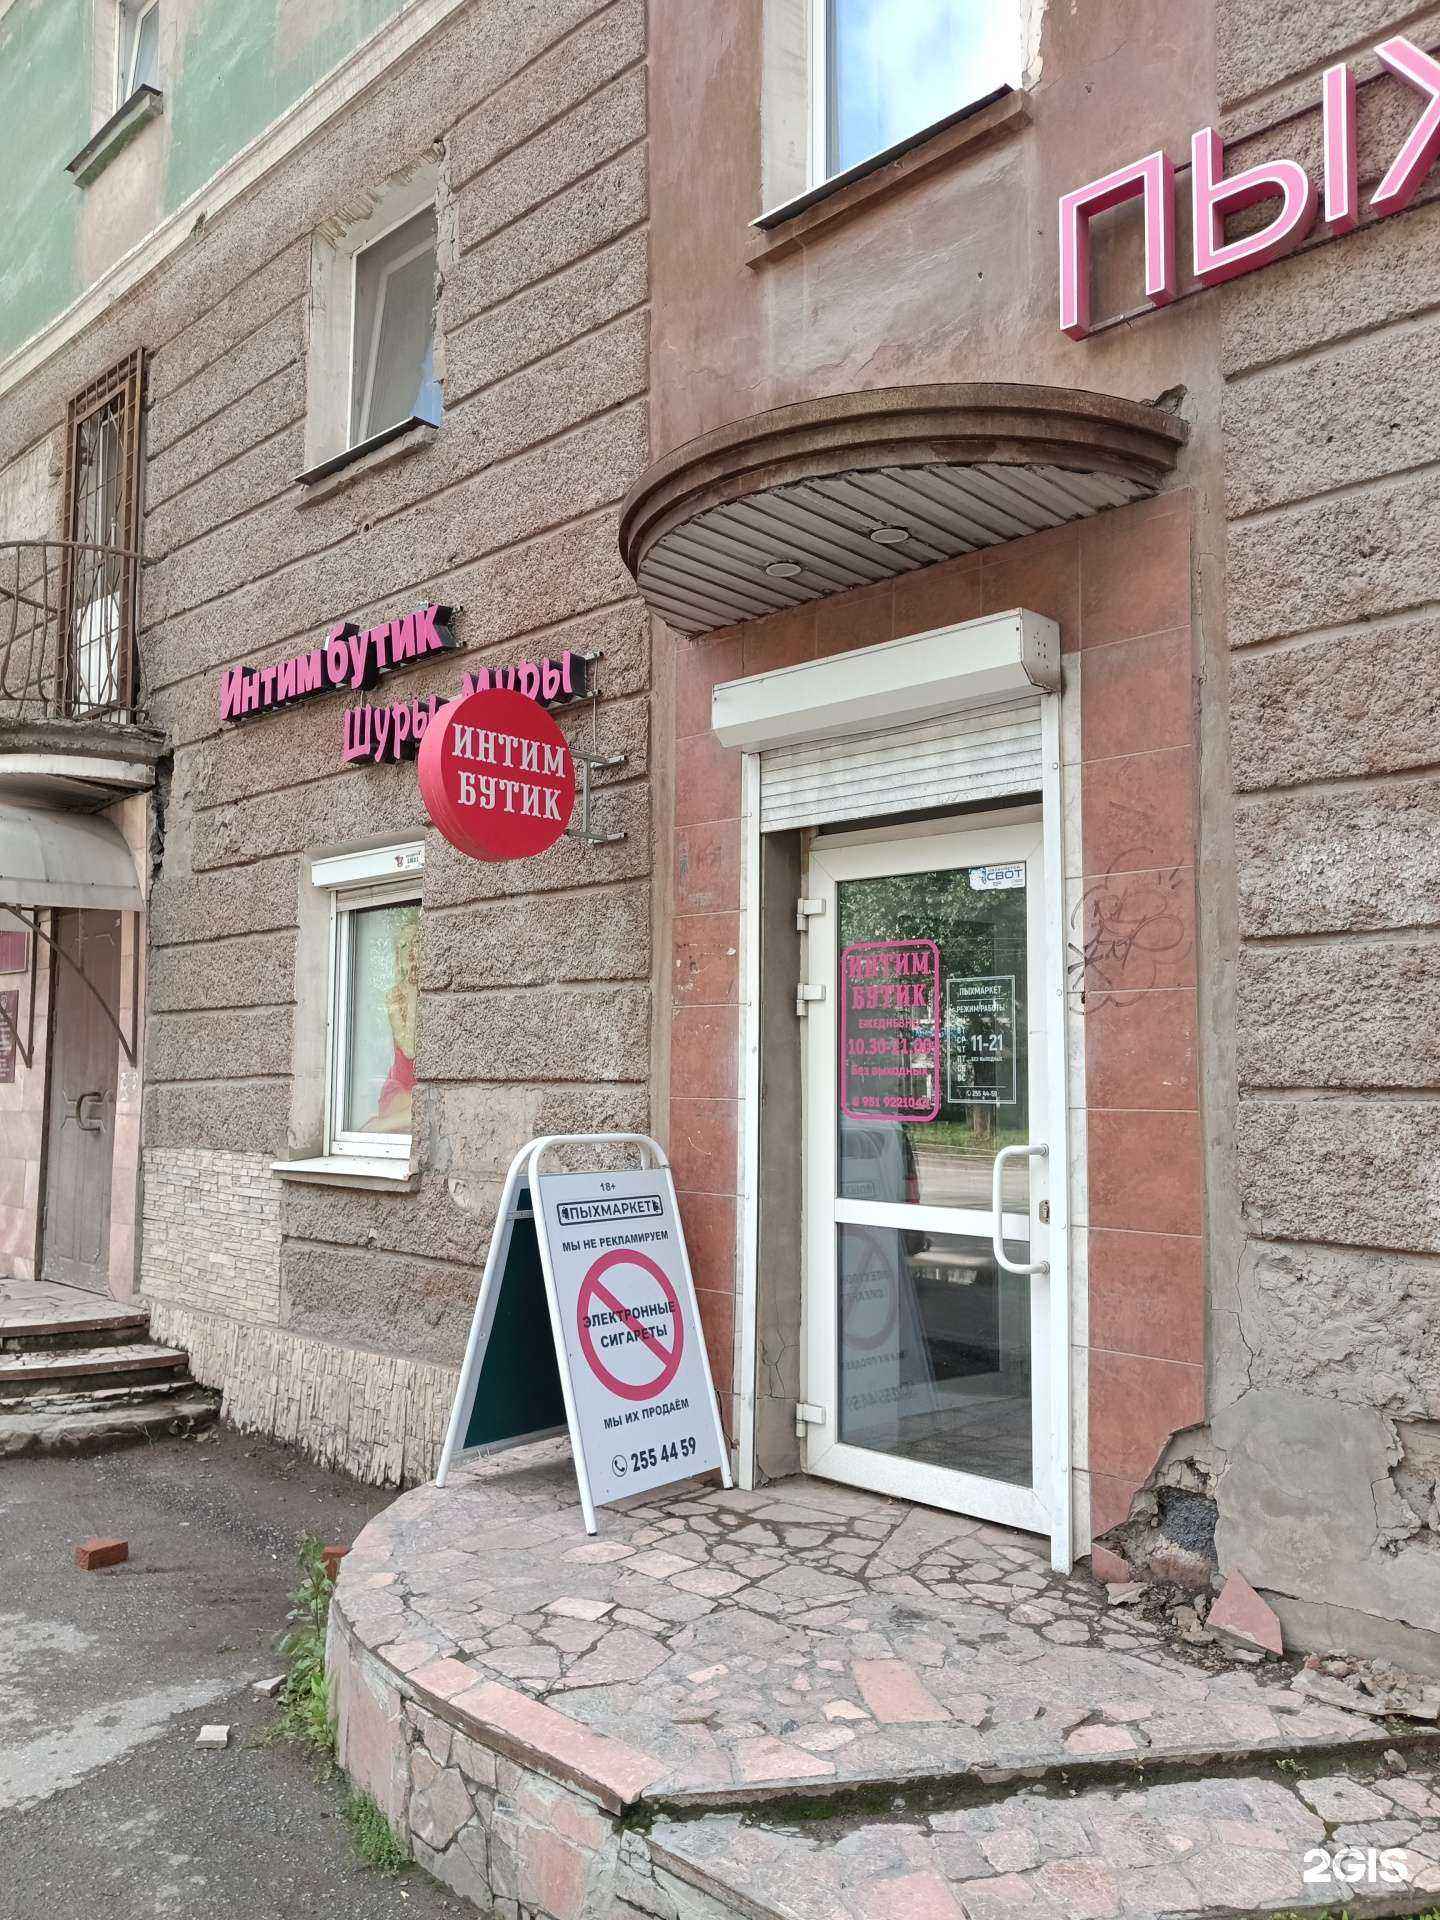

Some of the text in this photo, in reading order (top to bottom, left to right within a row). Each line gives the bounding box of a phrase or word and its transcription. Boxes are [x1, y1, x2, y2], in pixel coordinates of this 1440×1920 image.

[219, 650, 322, 721] Интим
[452, 723, 566, 778] ИНТИМ
[457, 771, 563, 822] БУТИК
[848, 952, 931, 978] ИНТИМ
[852, 984, 927, 1009] БУТИК
[959, 986, 1002, 996] ПЫХМАРКЕТ
[957, 1002, 1005, 1013] РЕЖИМ РАБОТЫ
[971, 1034, 1003, 1052] 11-21
[600, 1182, 616, 1192] 18+
[570, 1200, 651, 1220] ПЫХМАРКЕТ
[562, 1230, 669, 1253] МЫ НЕ РЕКЛАМИРУЕМ
[583, 1301, 675, 1328] ЭЛЕКТРОННЫЕ
[600, 1324, 668, 1348] СИГАРЕТЫ
[603, 1398, 690, 1430] МЫ ИХ ПРОДАЁМ
[630, 1436, 697, 1473] 255 44 59
